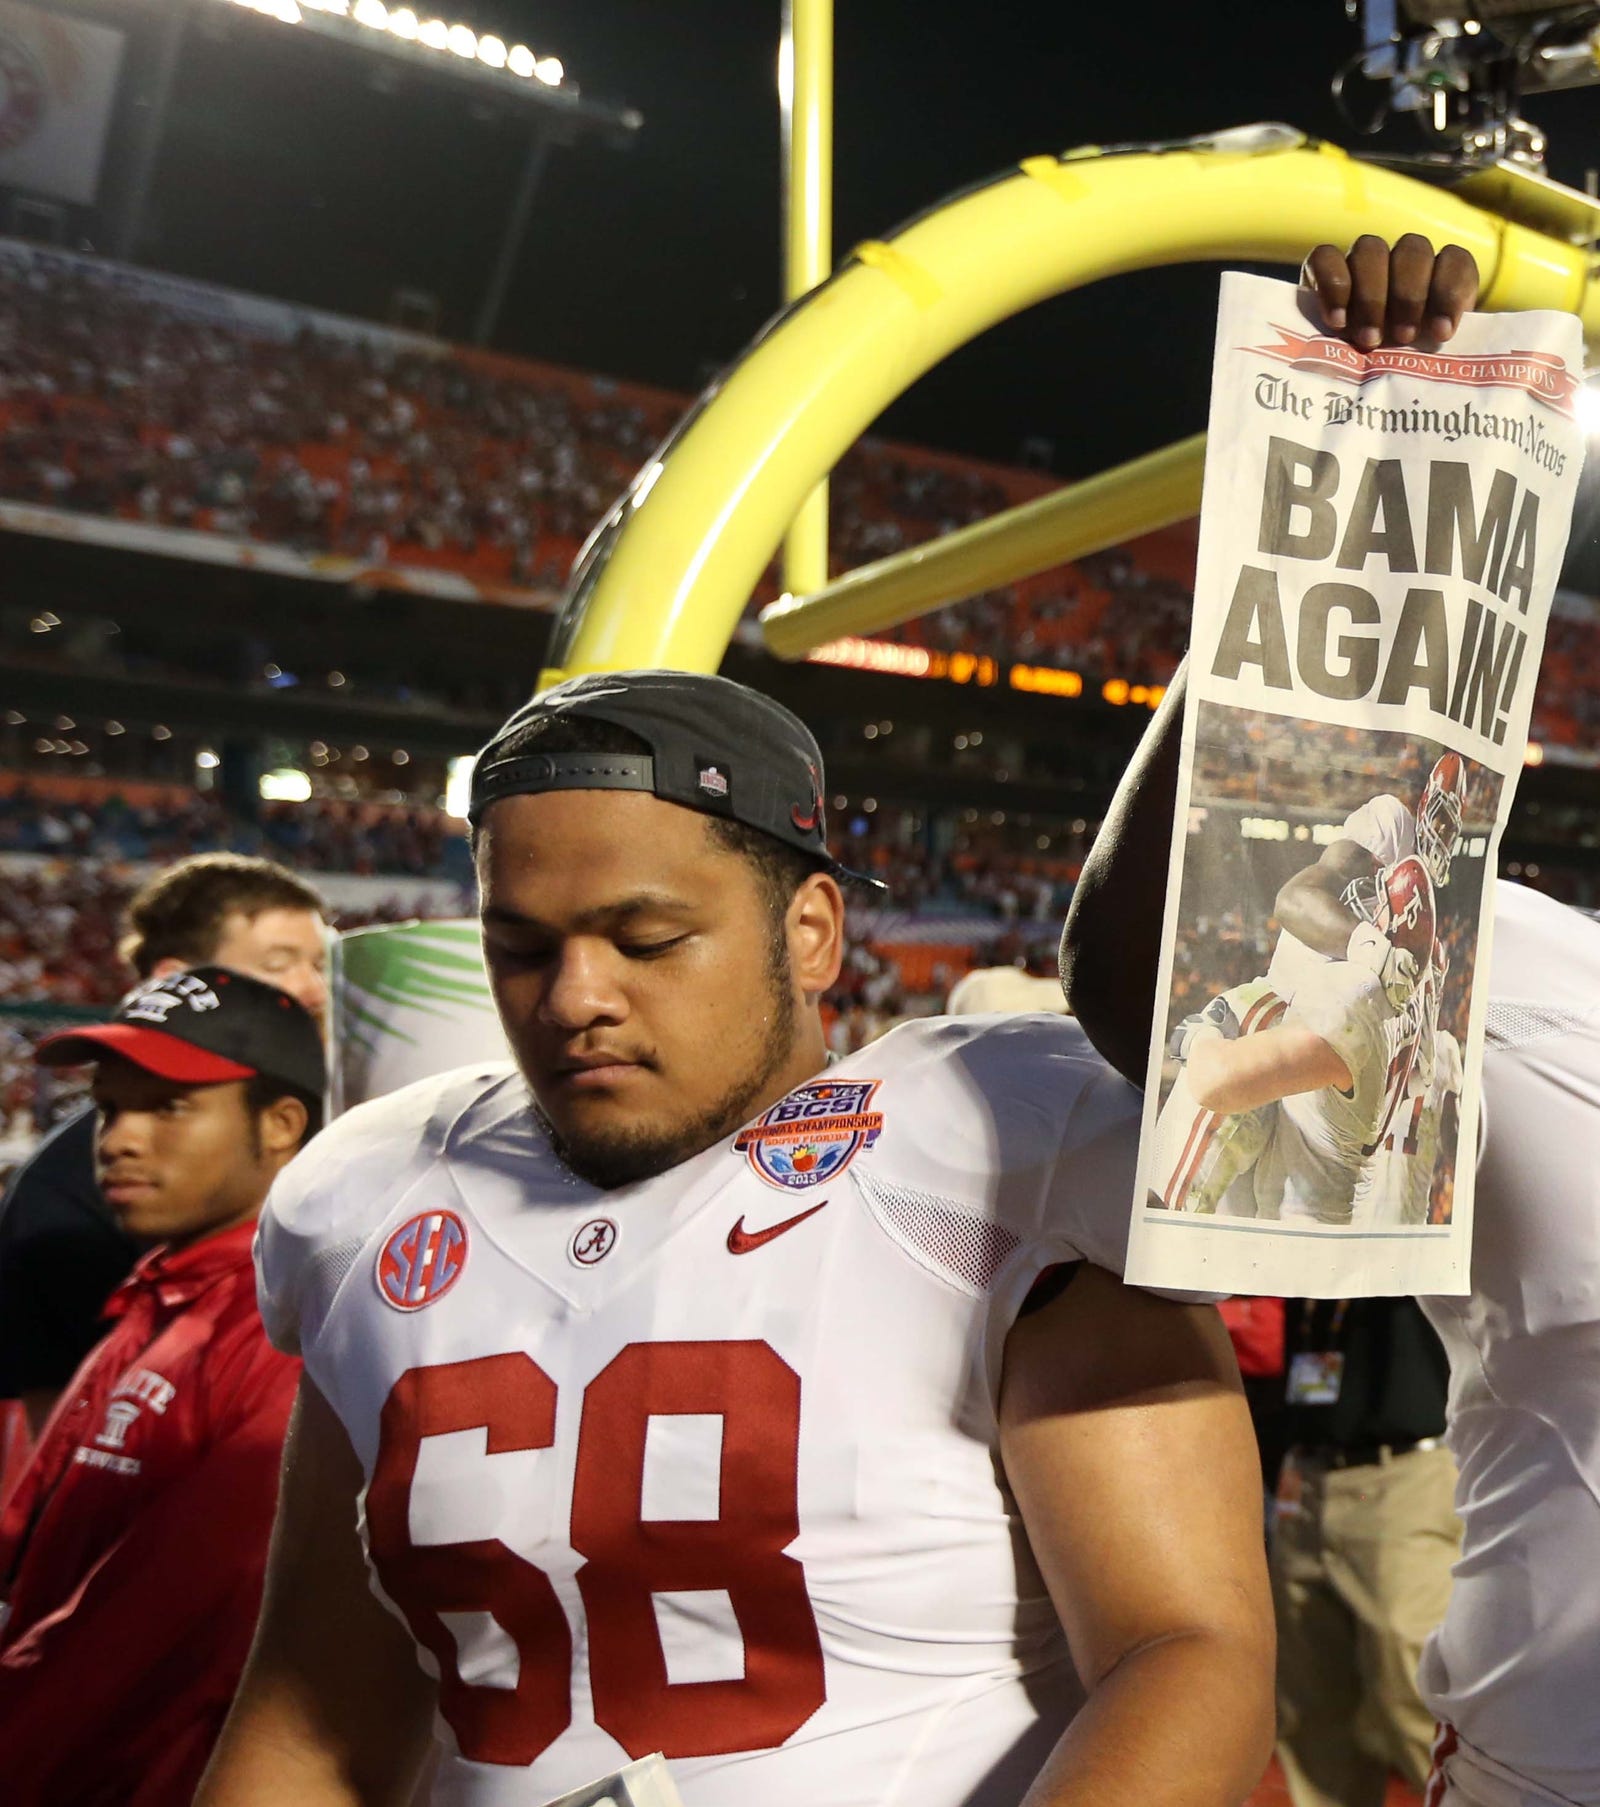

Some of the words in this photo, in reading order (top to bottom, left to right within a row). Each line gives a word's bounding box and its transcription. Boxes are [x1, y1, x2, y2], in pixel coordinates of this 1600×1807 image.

[1324, 344, 1357, 365] BCS
[1362, 351, 1454, 375] NATIONAL
[1458, 360, 1556, 390] CHAMPIONS
[1254, 373, 1313, 420] The
[1323, 391, 1525, 448] Birmingham
[1524, 414, 1567, 477] News
[1256, 435, 1540, 616] BAMA
[1210, 564, 1527, 746] AGAIN!
[740, 1124, 793, 1140] NATIONAL
[795, 1114, 881, 1131] CHAMPIONSHIP
[764, 1136, 800, 1147] SOUTH
[803, 1132, 850, 1144] FLORIDA
[774, 1097, 857, 1122] BCS
[787, 1173, 818, 1185] 2013
[385, 1214, 463, 1302] SEC
[366, 1339, 827, 1767] 68
